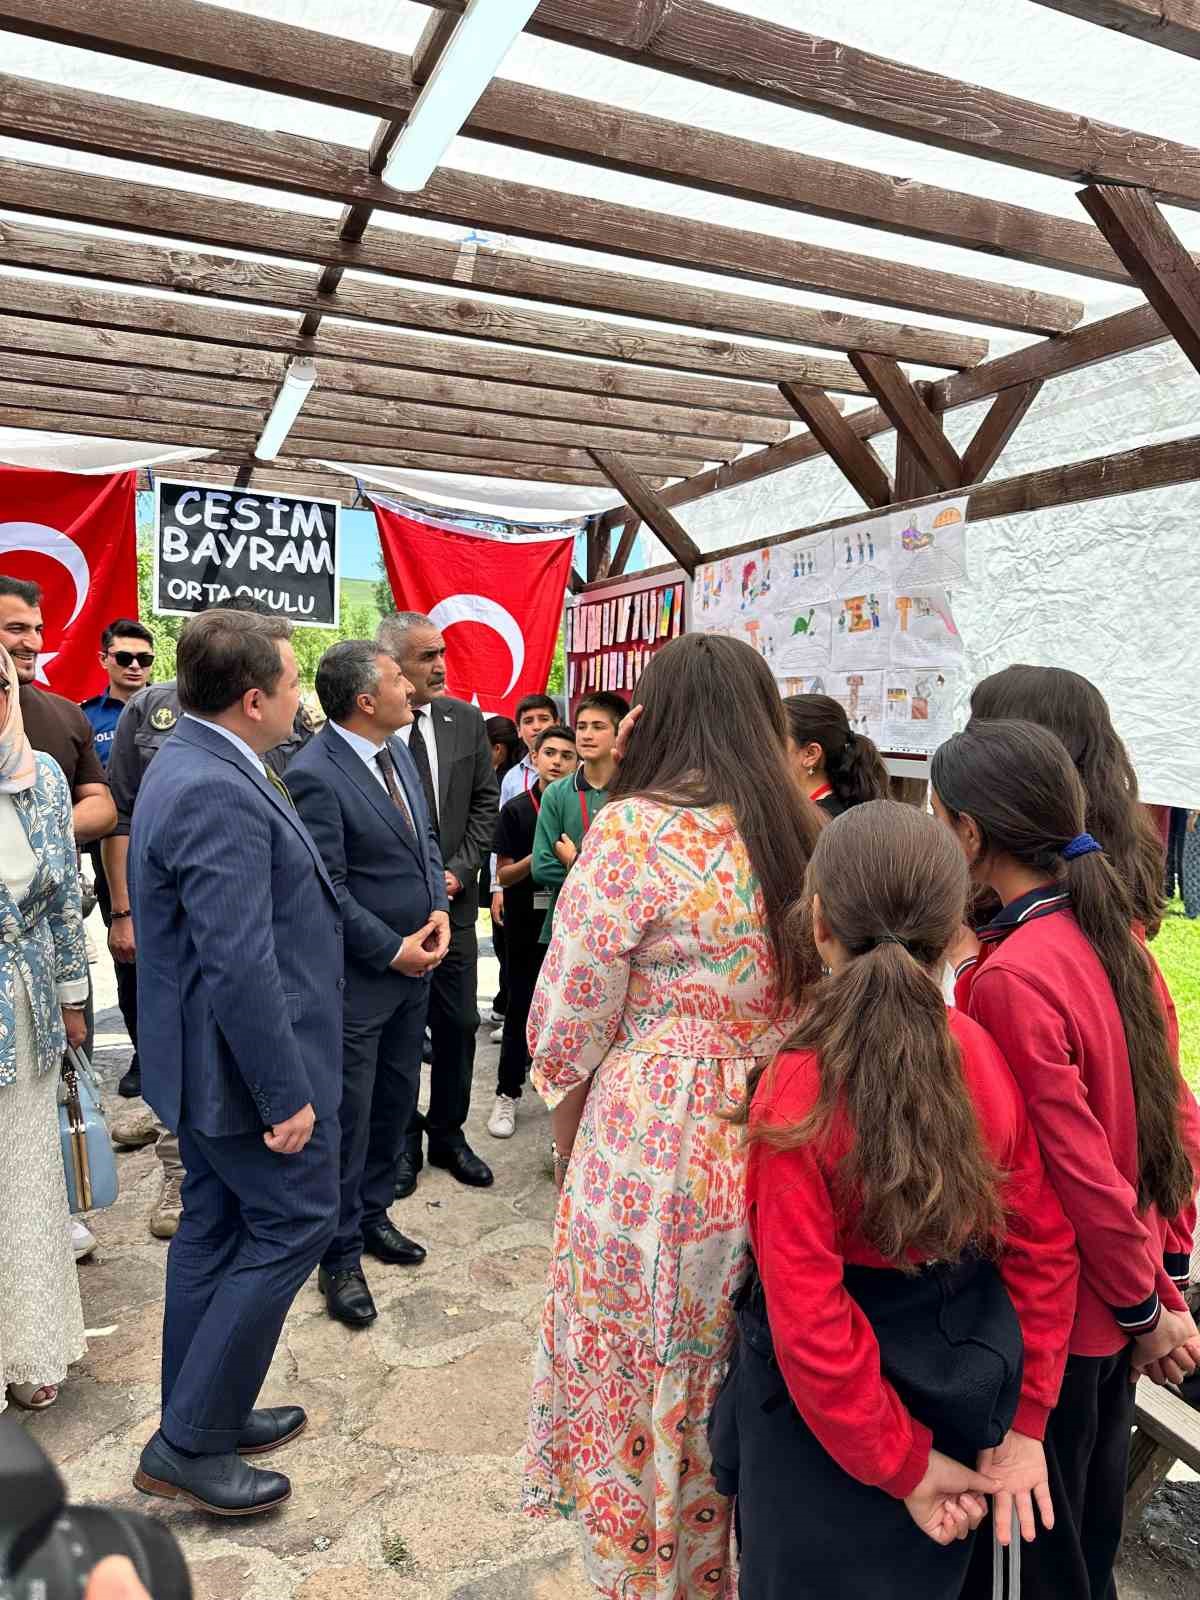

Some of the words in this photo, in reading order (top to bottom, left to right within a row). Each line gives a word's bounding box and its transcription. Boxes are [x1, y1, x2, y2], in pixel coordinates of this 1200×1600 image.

[174, 491, 328, 538] CESİM
[162, 526, 335, 575] BAYRAM
[94, 730, 114, 742] OLI
